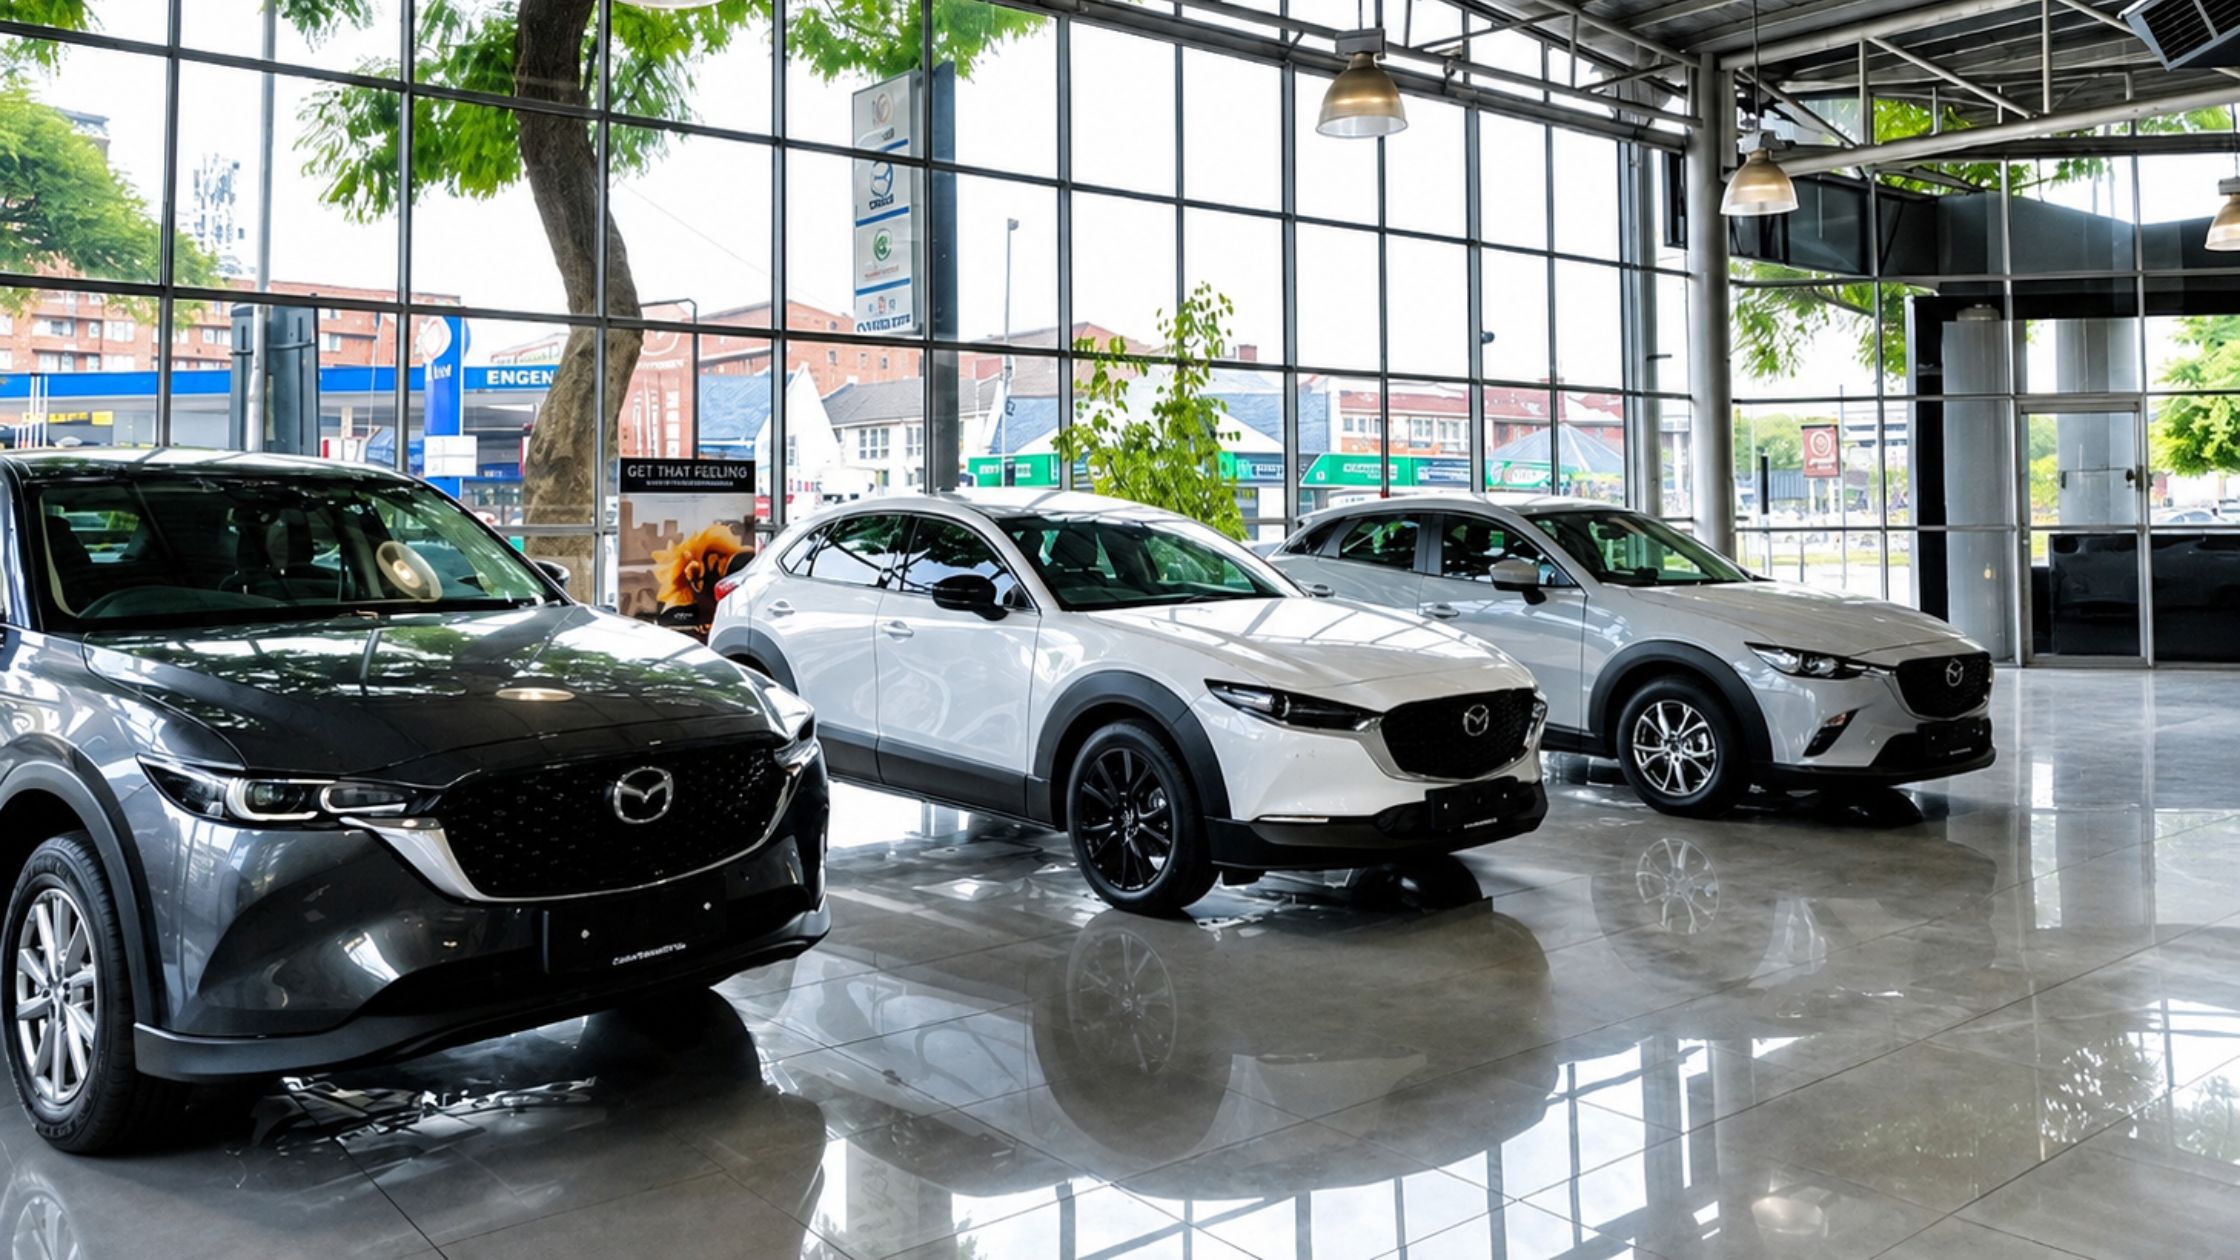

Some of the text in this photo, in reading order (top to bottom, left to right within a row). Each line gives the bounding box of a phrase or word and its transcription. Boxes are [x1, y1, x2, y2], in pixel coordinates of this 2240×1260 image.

[627, 465, 748, 479] GET THAT FEELING
